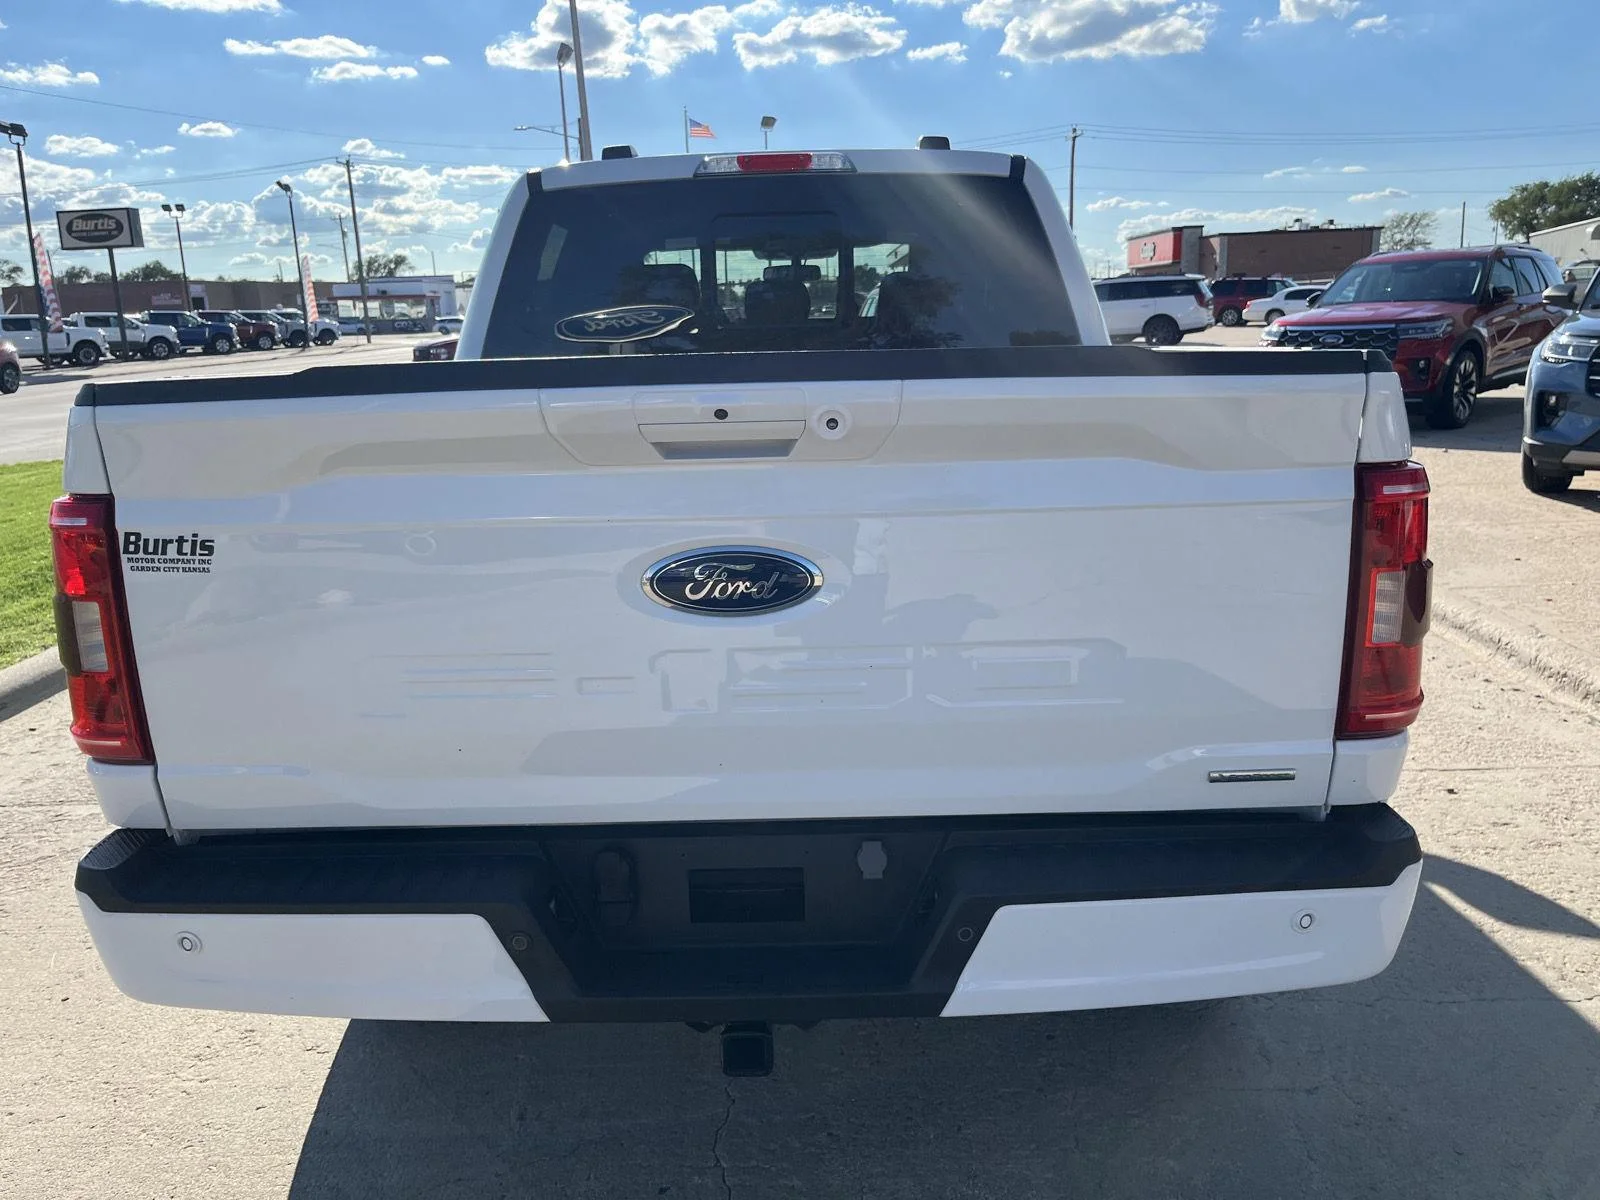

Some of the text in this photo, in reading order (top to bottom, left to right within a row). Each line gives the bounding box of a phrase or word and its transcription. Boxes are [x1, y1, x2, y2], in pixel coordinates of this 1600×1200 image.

[72, 217, 117, 231] Burtis
[122, 531, 216, 557] Burtis
[157, 557, 196, 565] COMPANY
[130, 565, 161, 573] GARDEN
[684, 562, 780, 601] Ford
